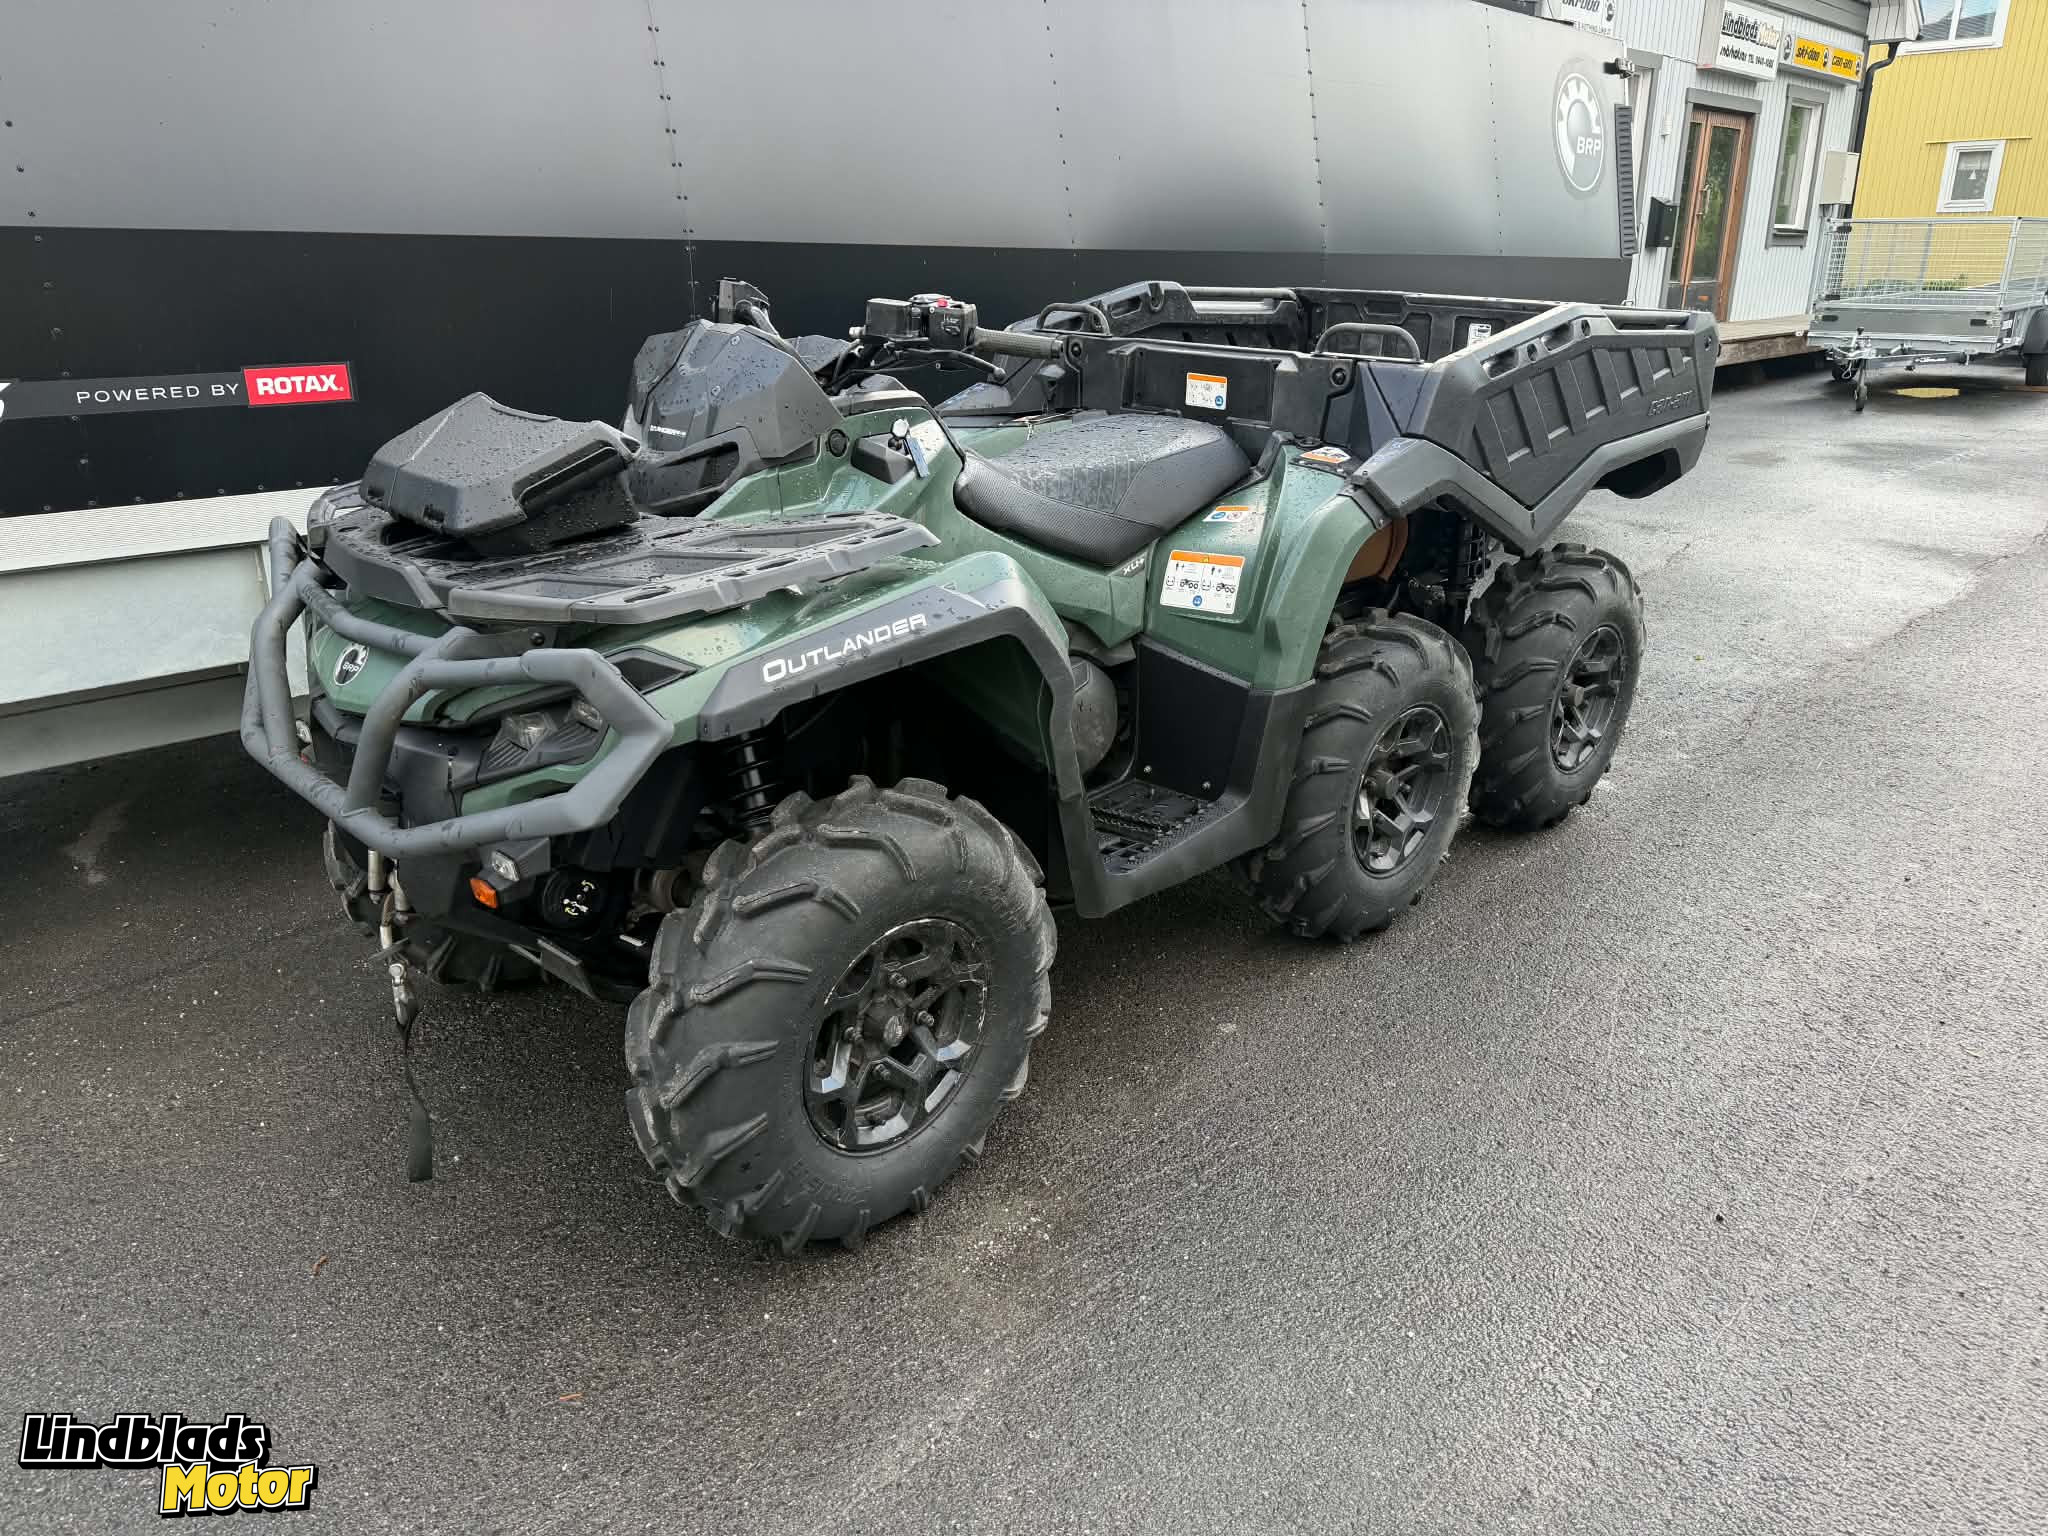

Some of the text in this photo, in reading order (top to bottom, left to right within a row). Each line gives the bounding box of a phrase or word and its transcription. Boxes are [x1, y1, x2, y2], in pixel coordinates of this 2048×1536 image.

[1576, 136, 1601, 156] BRP
[76, 373, 340, 404] POWERED BY ROTAX
[762, 613, 928, 683] OUTLANDER
[342, 661, 359, 672] BRP
